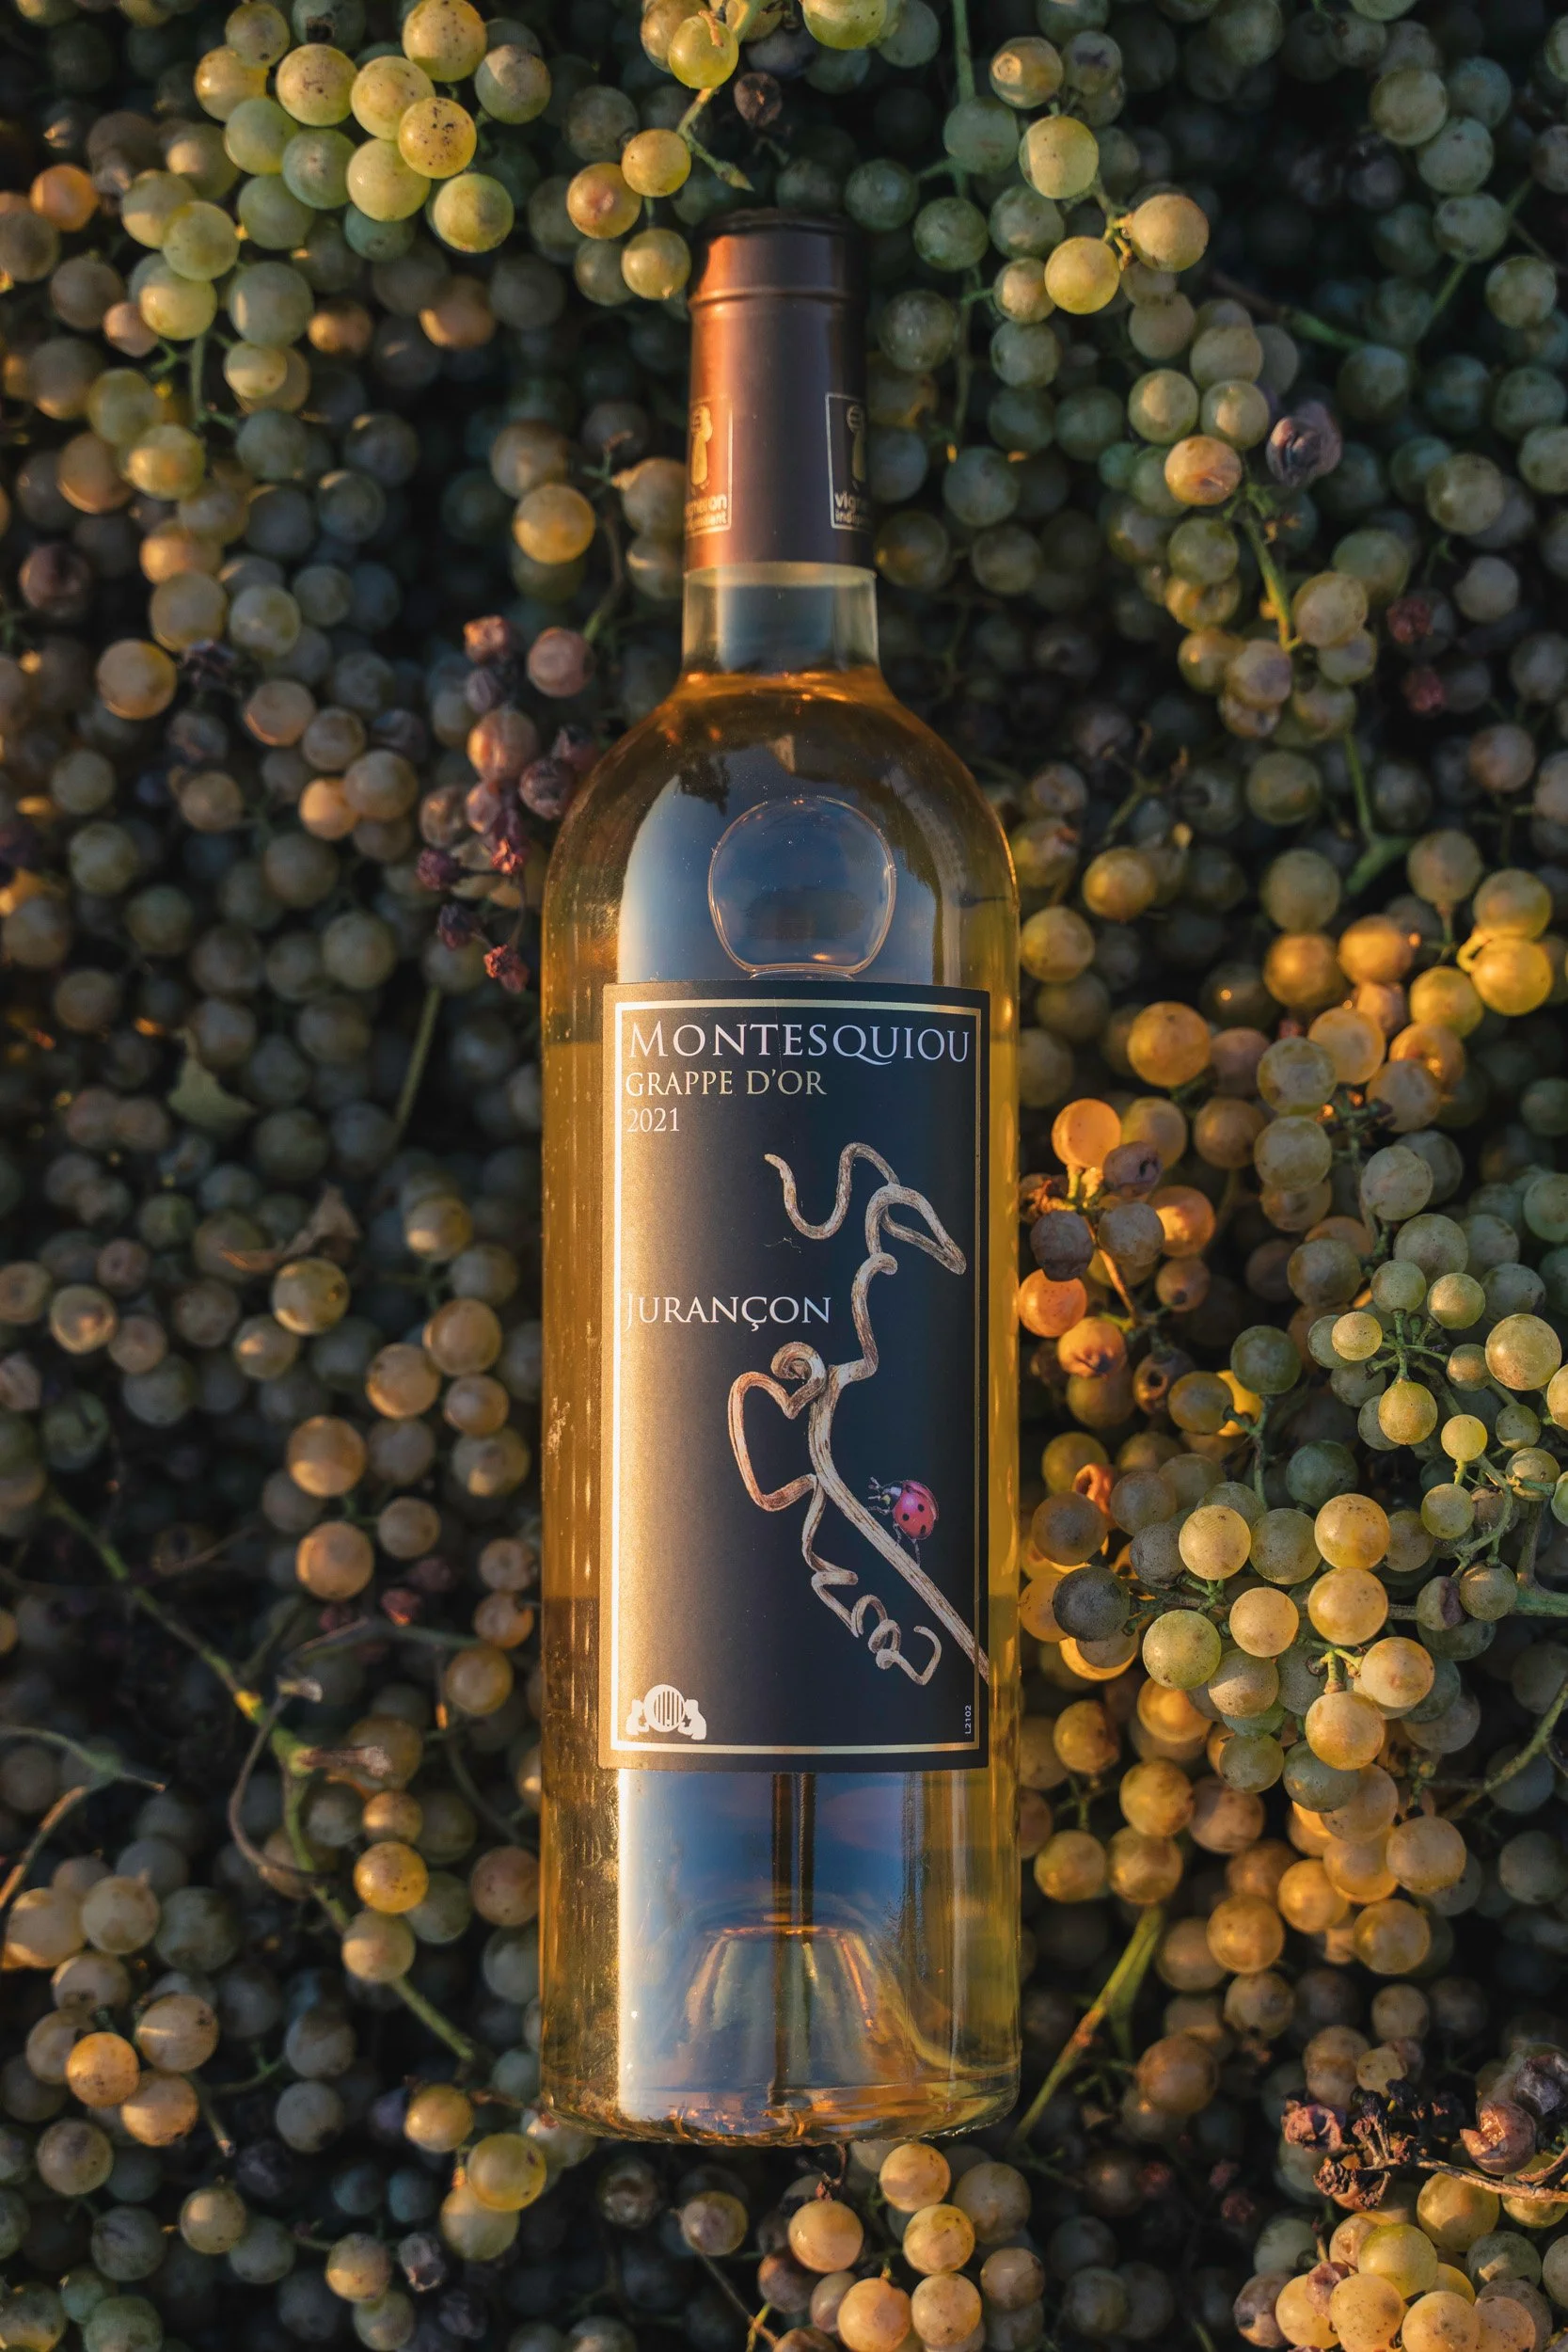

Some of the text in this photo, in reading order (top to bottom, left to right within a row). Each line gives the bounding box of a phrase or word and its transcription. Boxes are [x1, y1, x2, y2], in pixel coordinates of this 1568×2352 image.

[628, 1020, 970, 1066] MONTESQUIOU
[626, 1068, 828, 1097] GRAPPE D'OR
[626, 1106, 680, 1134] 2021
[624, 1291, 832, 1332] JURANÇON
